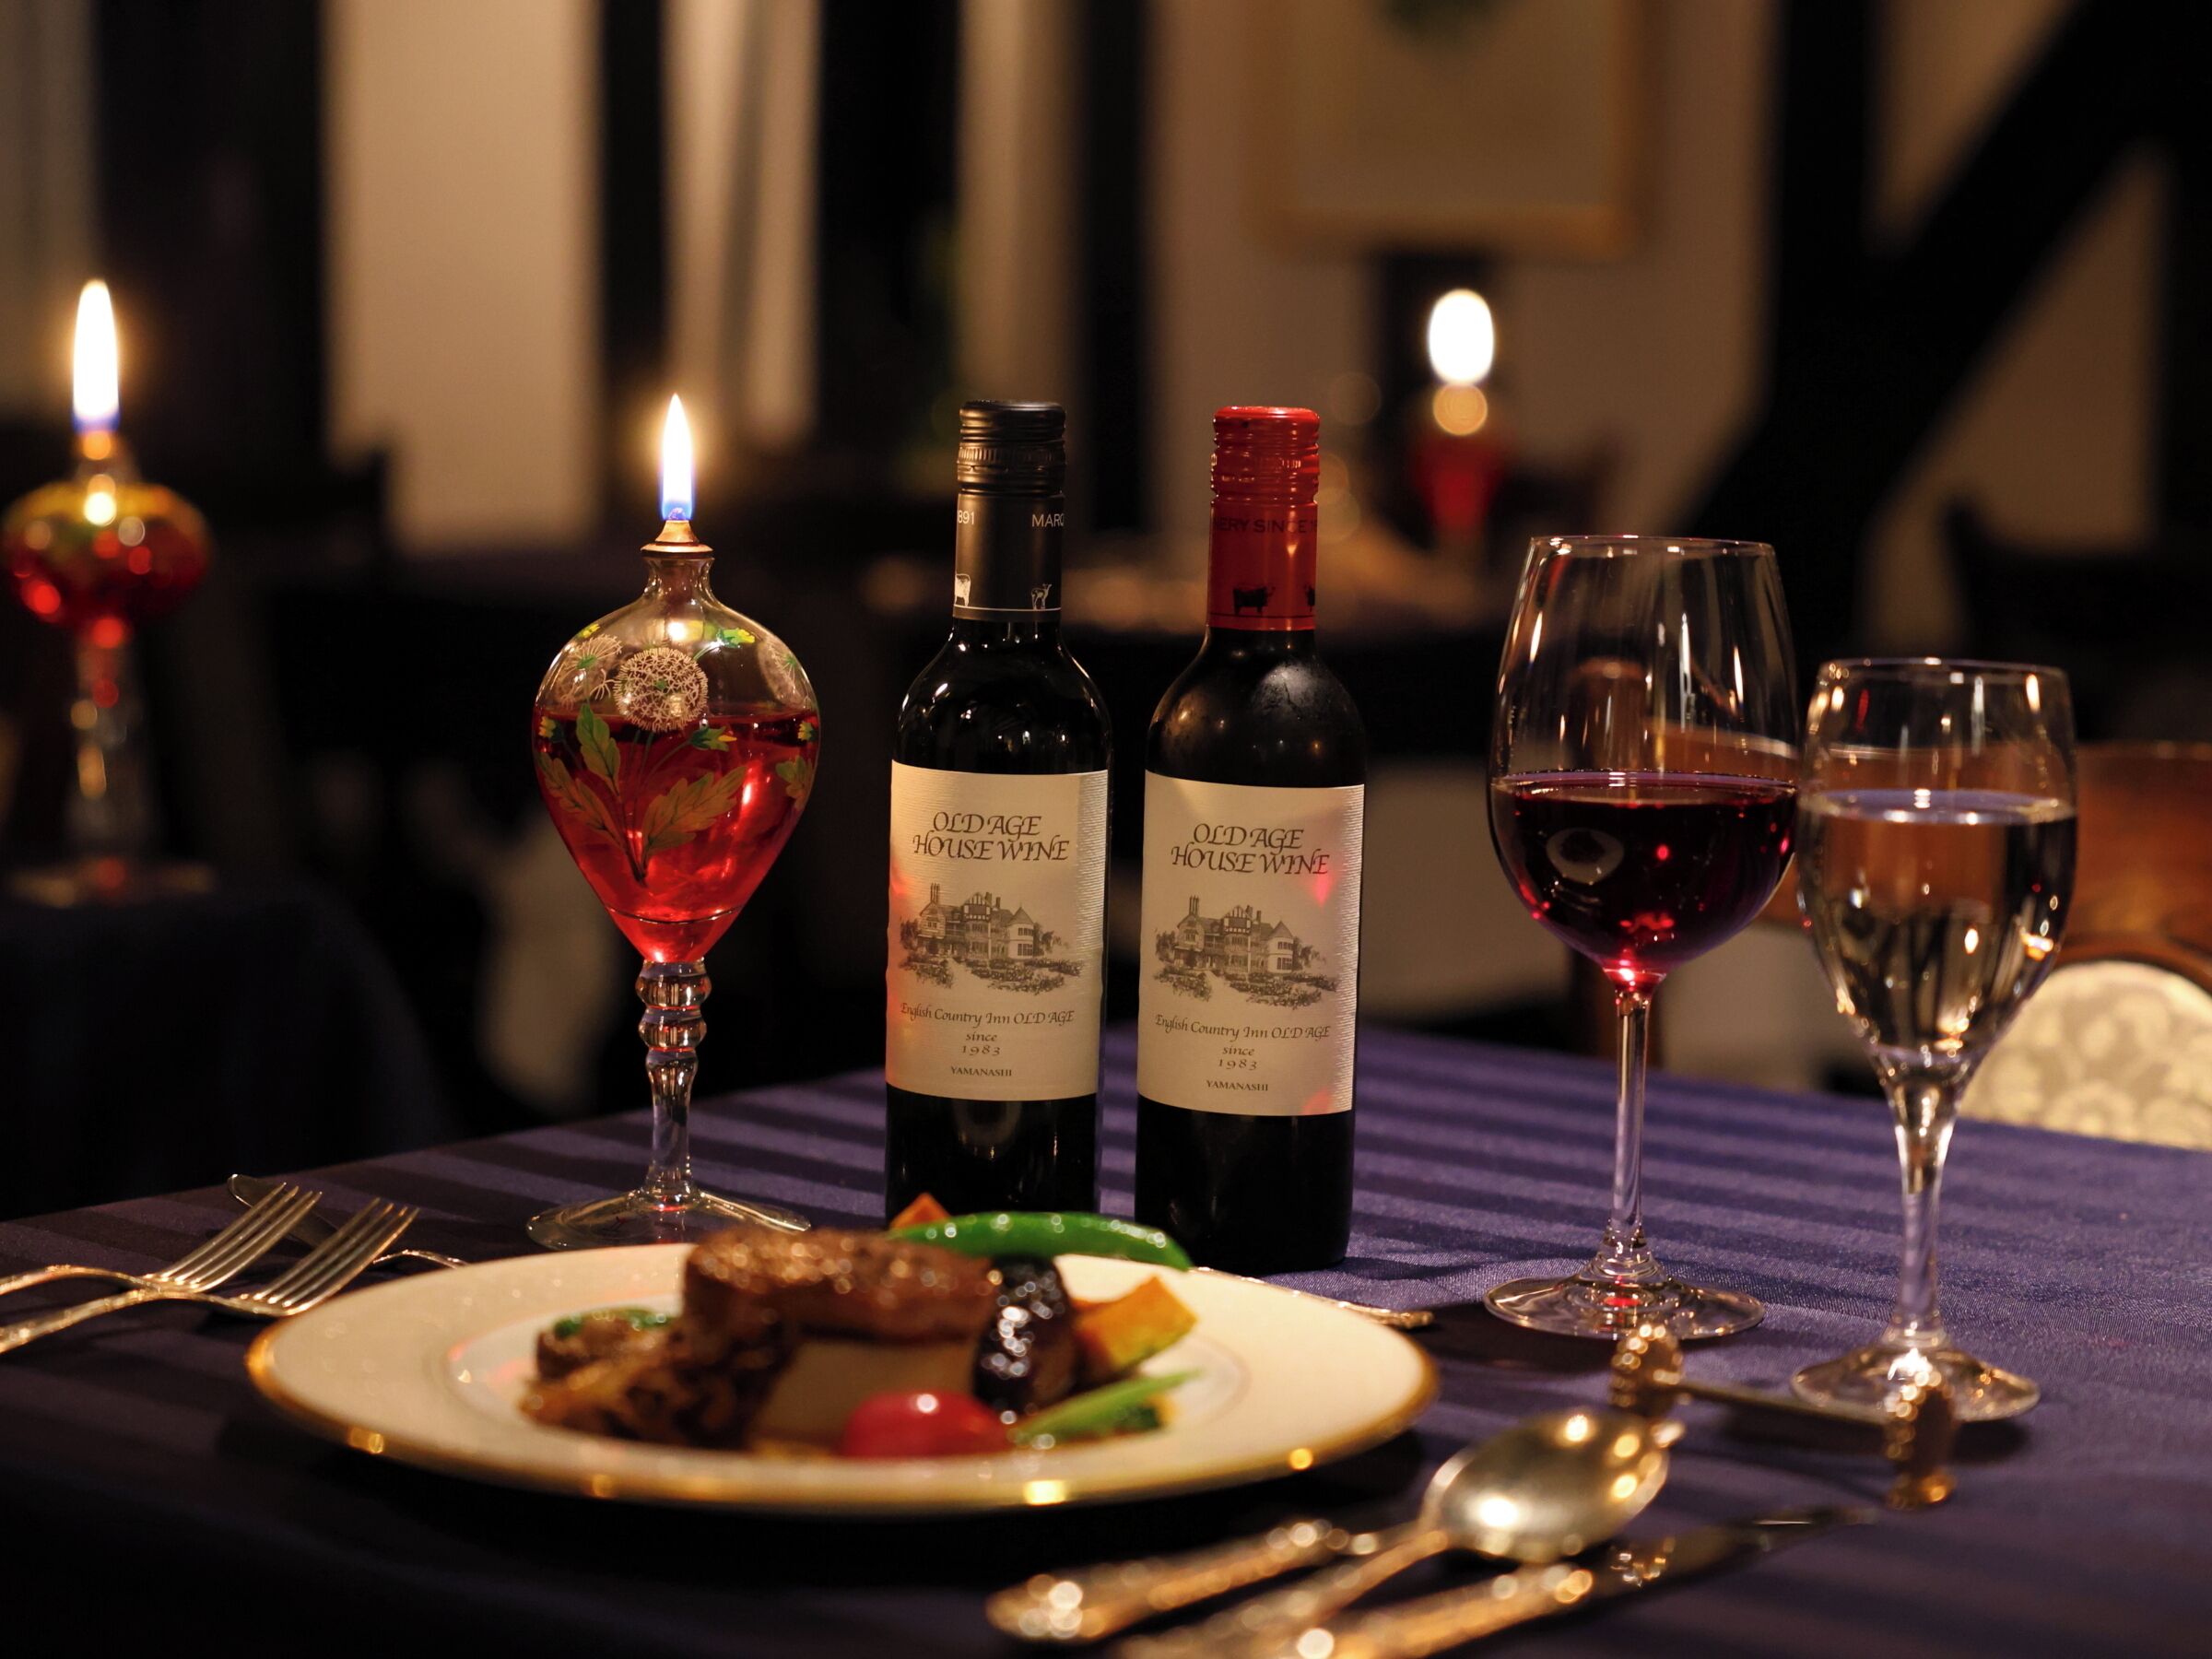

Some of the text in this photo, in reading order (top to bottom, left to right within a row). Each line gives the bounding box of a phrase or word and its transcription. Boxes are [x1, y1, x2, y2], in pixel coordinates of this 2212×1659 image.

[1253, 519, 1308, 533] SINCE
[933, 811, 1041, 841] OLD AGE
[912, 829, 1070, 862] HOUSE WINE
[1193, 822, 1304, 855] OLD AGE
[1171, 841, 1330, 876] HOUSE WINE
[900, 1002, 1076, 1029] English Country Inn OLD AGE
[1155, 1013, 1332, 1042] English Country Inn OLD AGE
[965, 1030, 998, 1041] since
[962, 1044, 1001, 1056] 1983
[1222, 1044, 1255, 1057] since
[950, 1065, 1012, 1077] YAMANASHI
[1218, 1059, 1258, 1071] 1983
[1206, 1079, 1269, 1092] YAMANASHI
